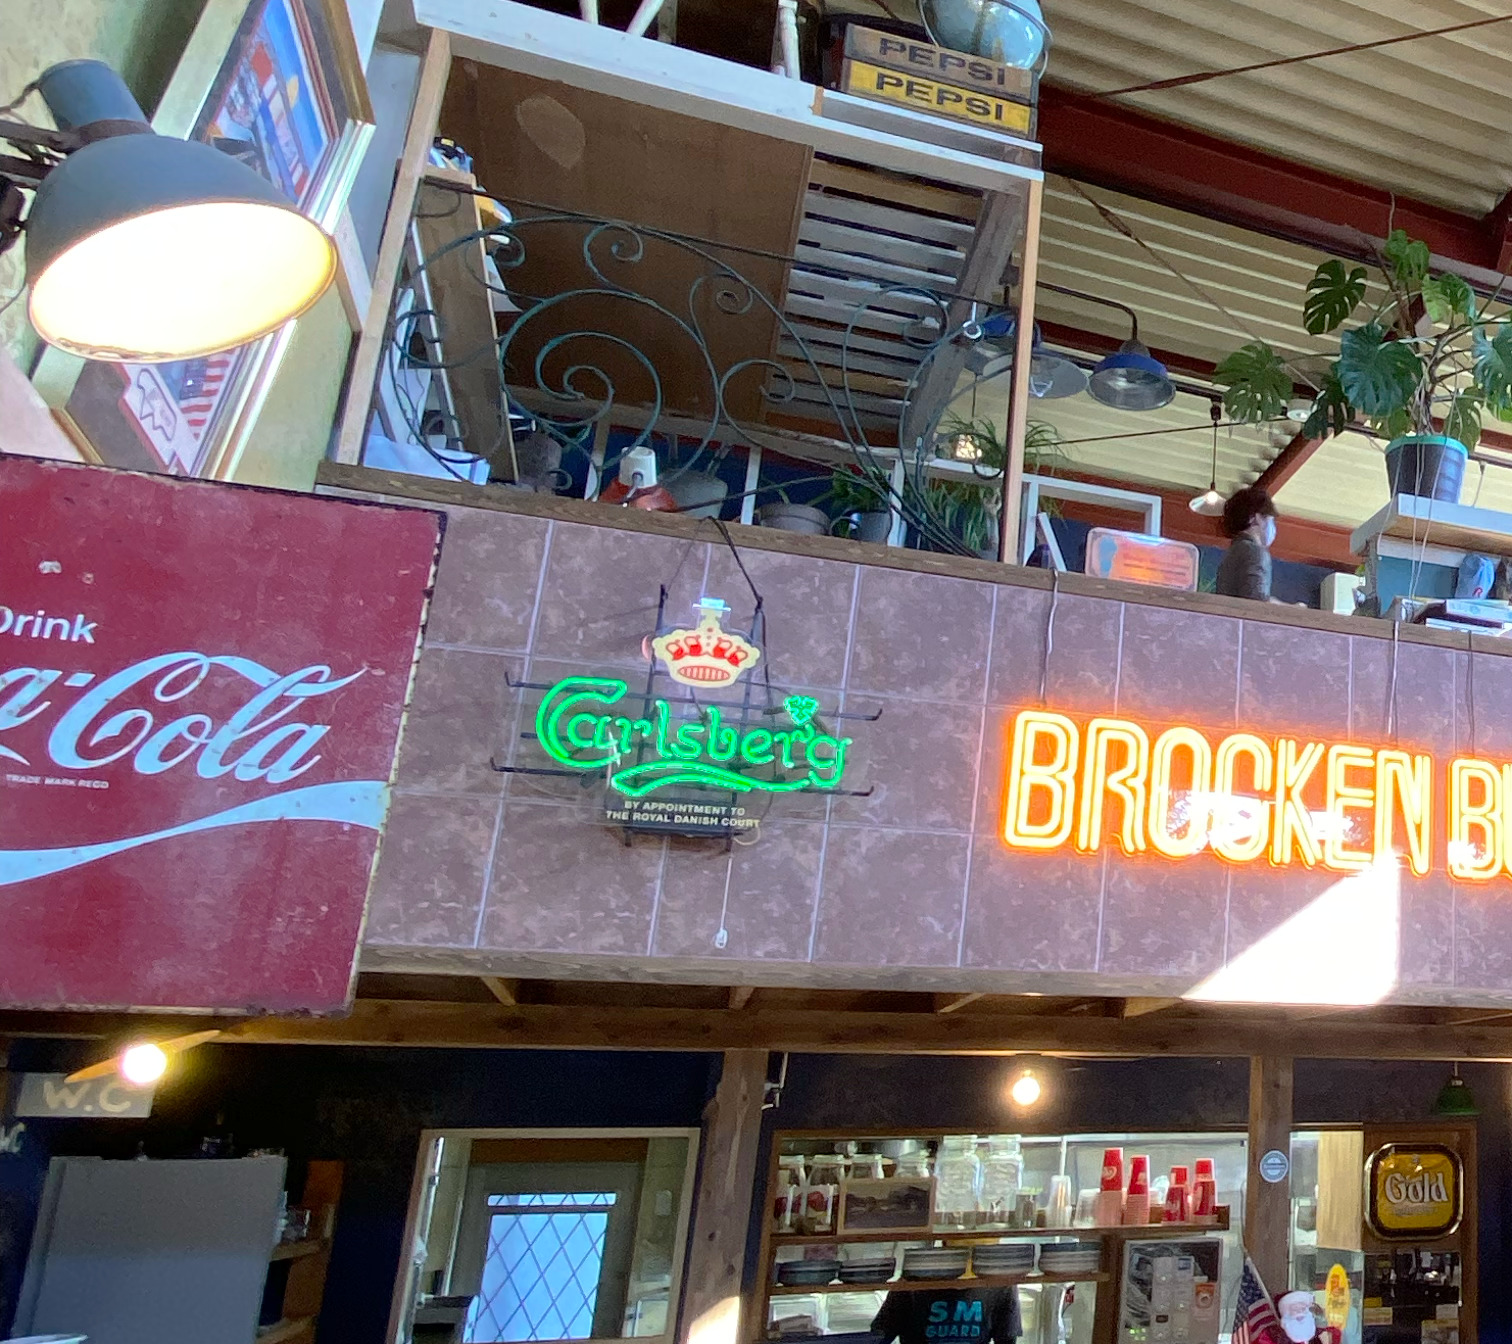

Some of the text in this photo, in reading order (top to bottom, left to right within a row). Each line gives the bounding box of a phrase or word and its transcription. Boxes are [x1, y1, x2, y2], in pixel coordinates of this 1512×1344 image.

[879, 37, 1006, 86] PEPSI
[875, 72, 1004, 122] PEPSI
[0, 651, 367, 785] a-Cola
[535, 676, 853, 799] Carlsberg
[623, 800, 746, 817] BY APPOINTMENT TO
[1001, 708, 1434, 878] BROCKEN
[605, 810, 761, 829] THE ROYAL DANISH COURT
[1385, 1172, 1449, 1204] Gold
[925, 1324, 982, 1338] GUARD
